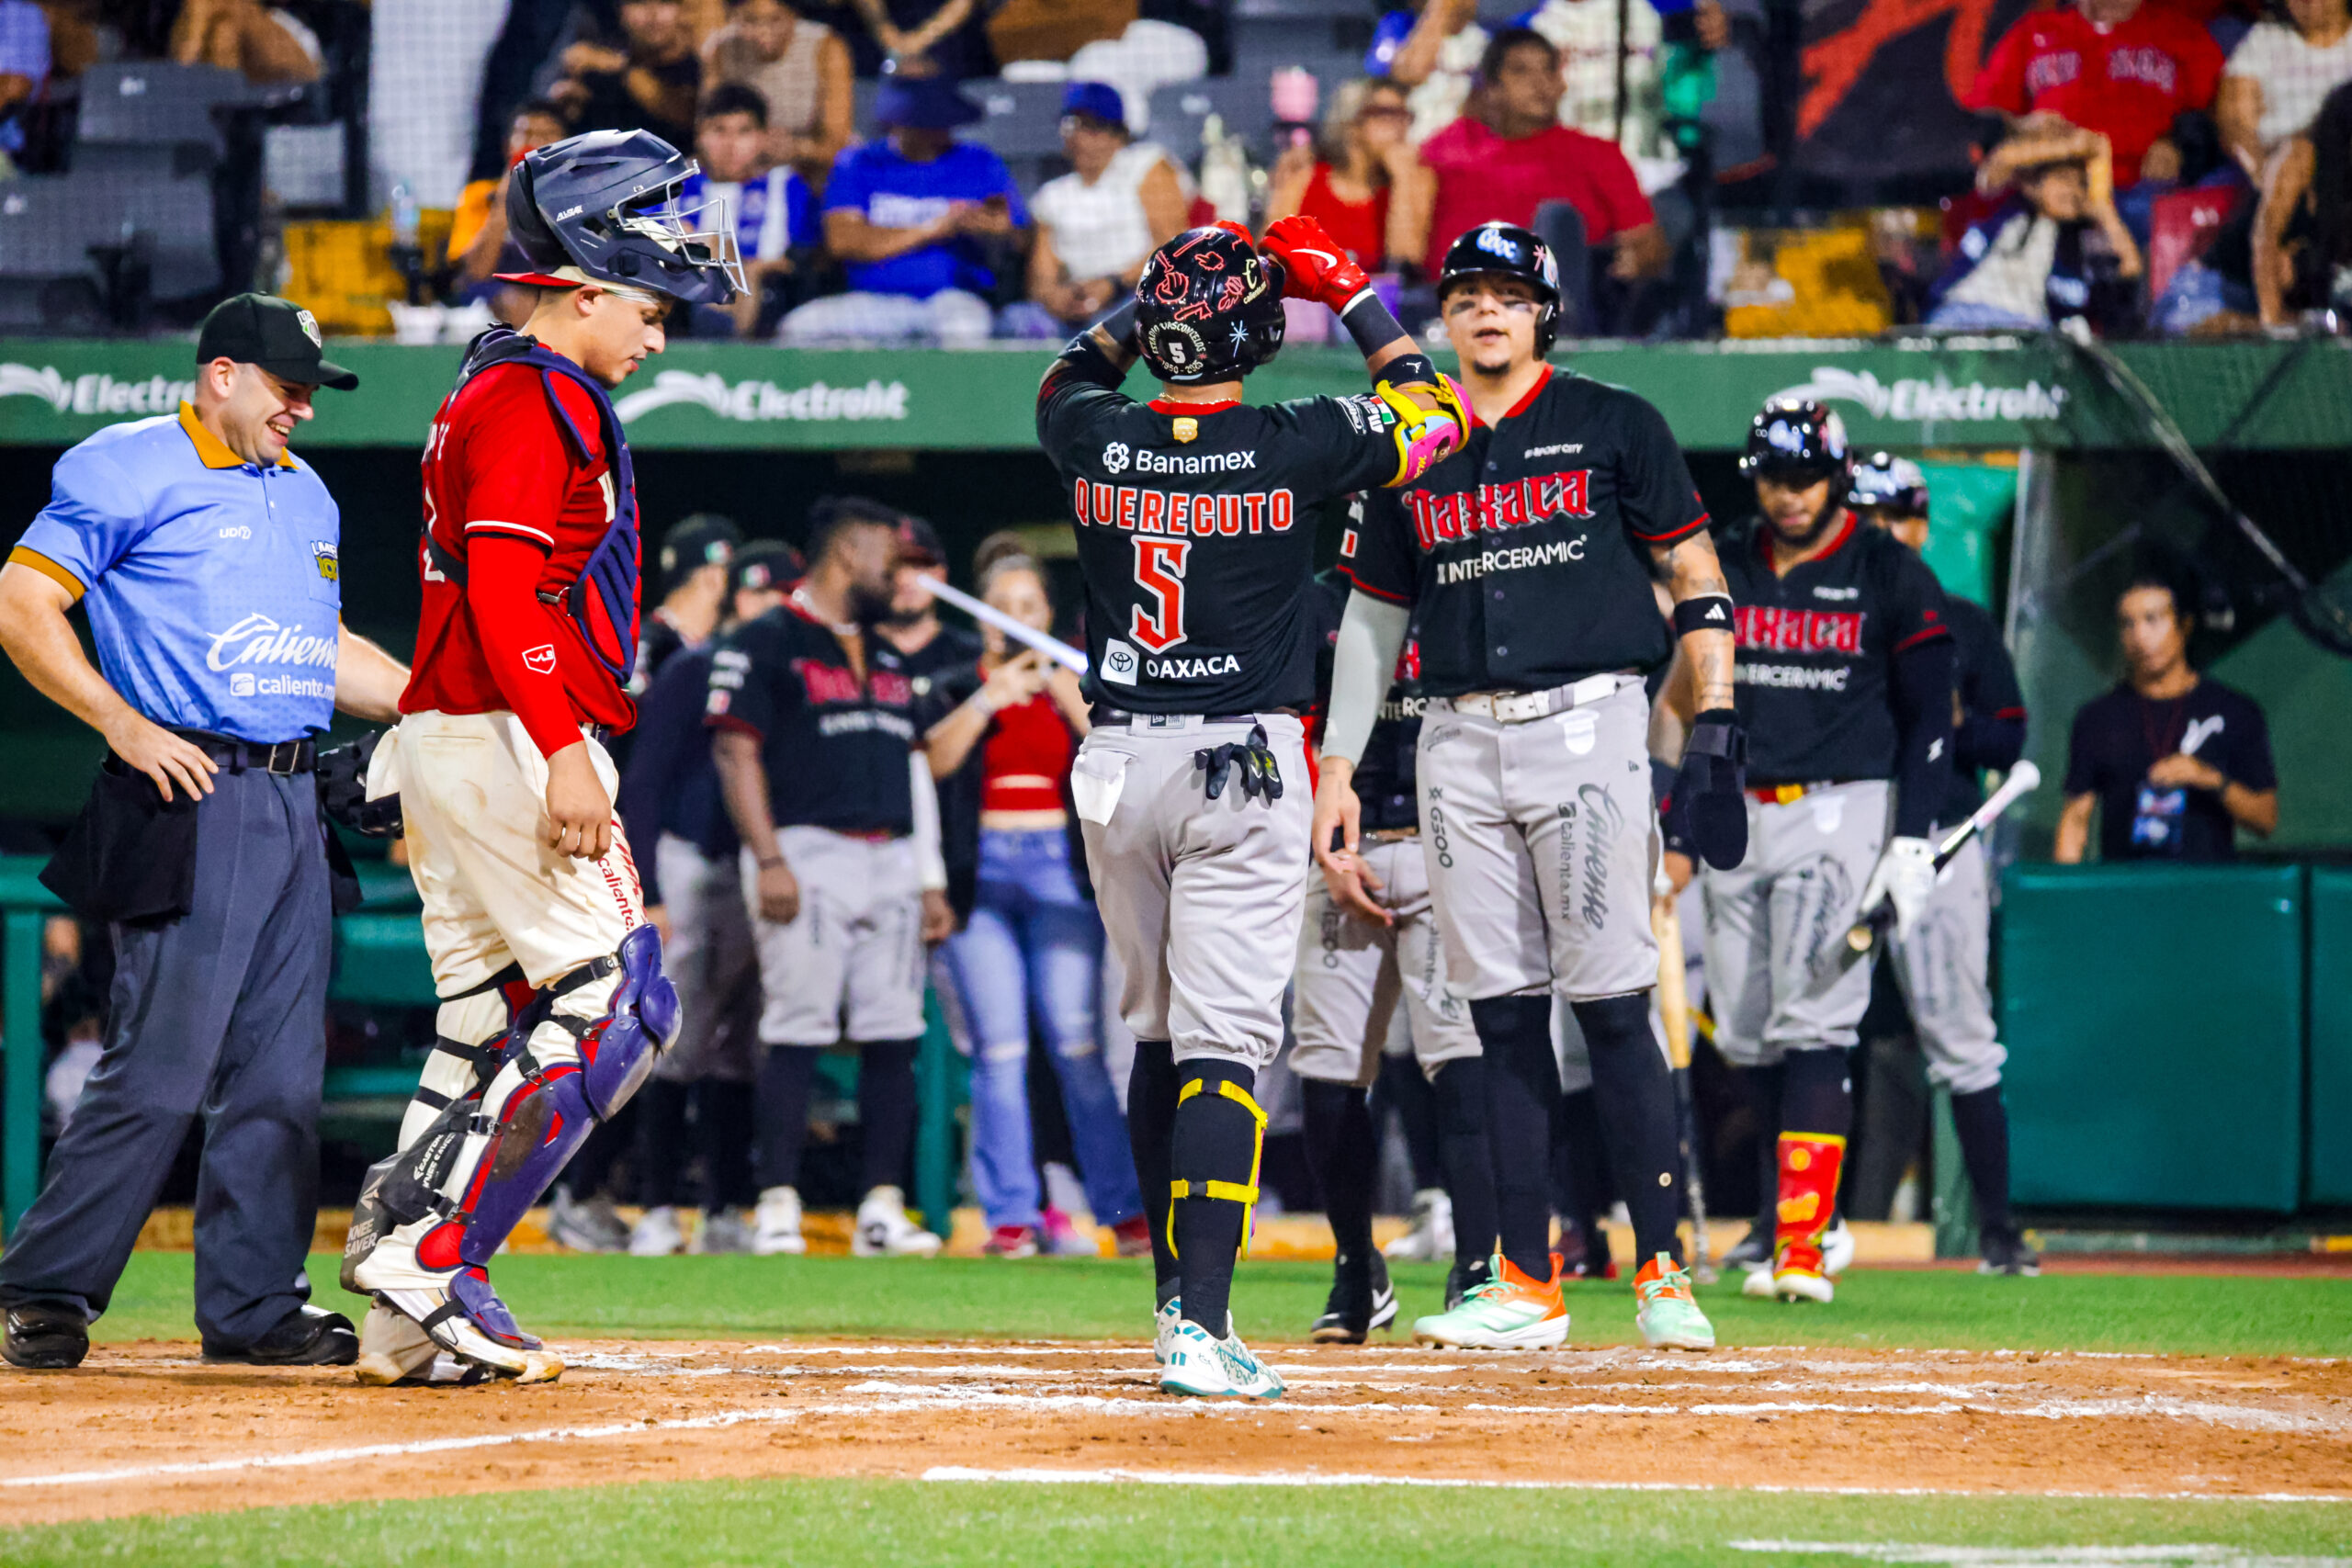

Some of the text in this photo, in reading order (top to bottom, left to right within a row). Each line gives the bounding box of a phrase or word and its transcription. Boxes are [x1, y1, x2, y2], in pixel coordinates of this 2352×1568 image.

[1159, 321, 1206, 352] VASCONCELOS
[1168, 342, 1186, 364] 5
[1161, 360, 1180, 374] 1950
[1136, 449, 1256, 474] Banamex
[1075, 477, 1294, 536] QUERECUTO
[1449, 539, 1586, 583] INTERCERAMIC
[1129, 534, 1193, 655] 5
[1147, 654, 1241, 678] OAXACA
[1430, 807, 1453, 869] G500
[347, 1218, 375, 1242] KNEE
[345, 1232, 378, 1258] SAVER
